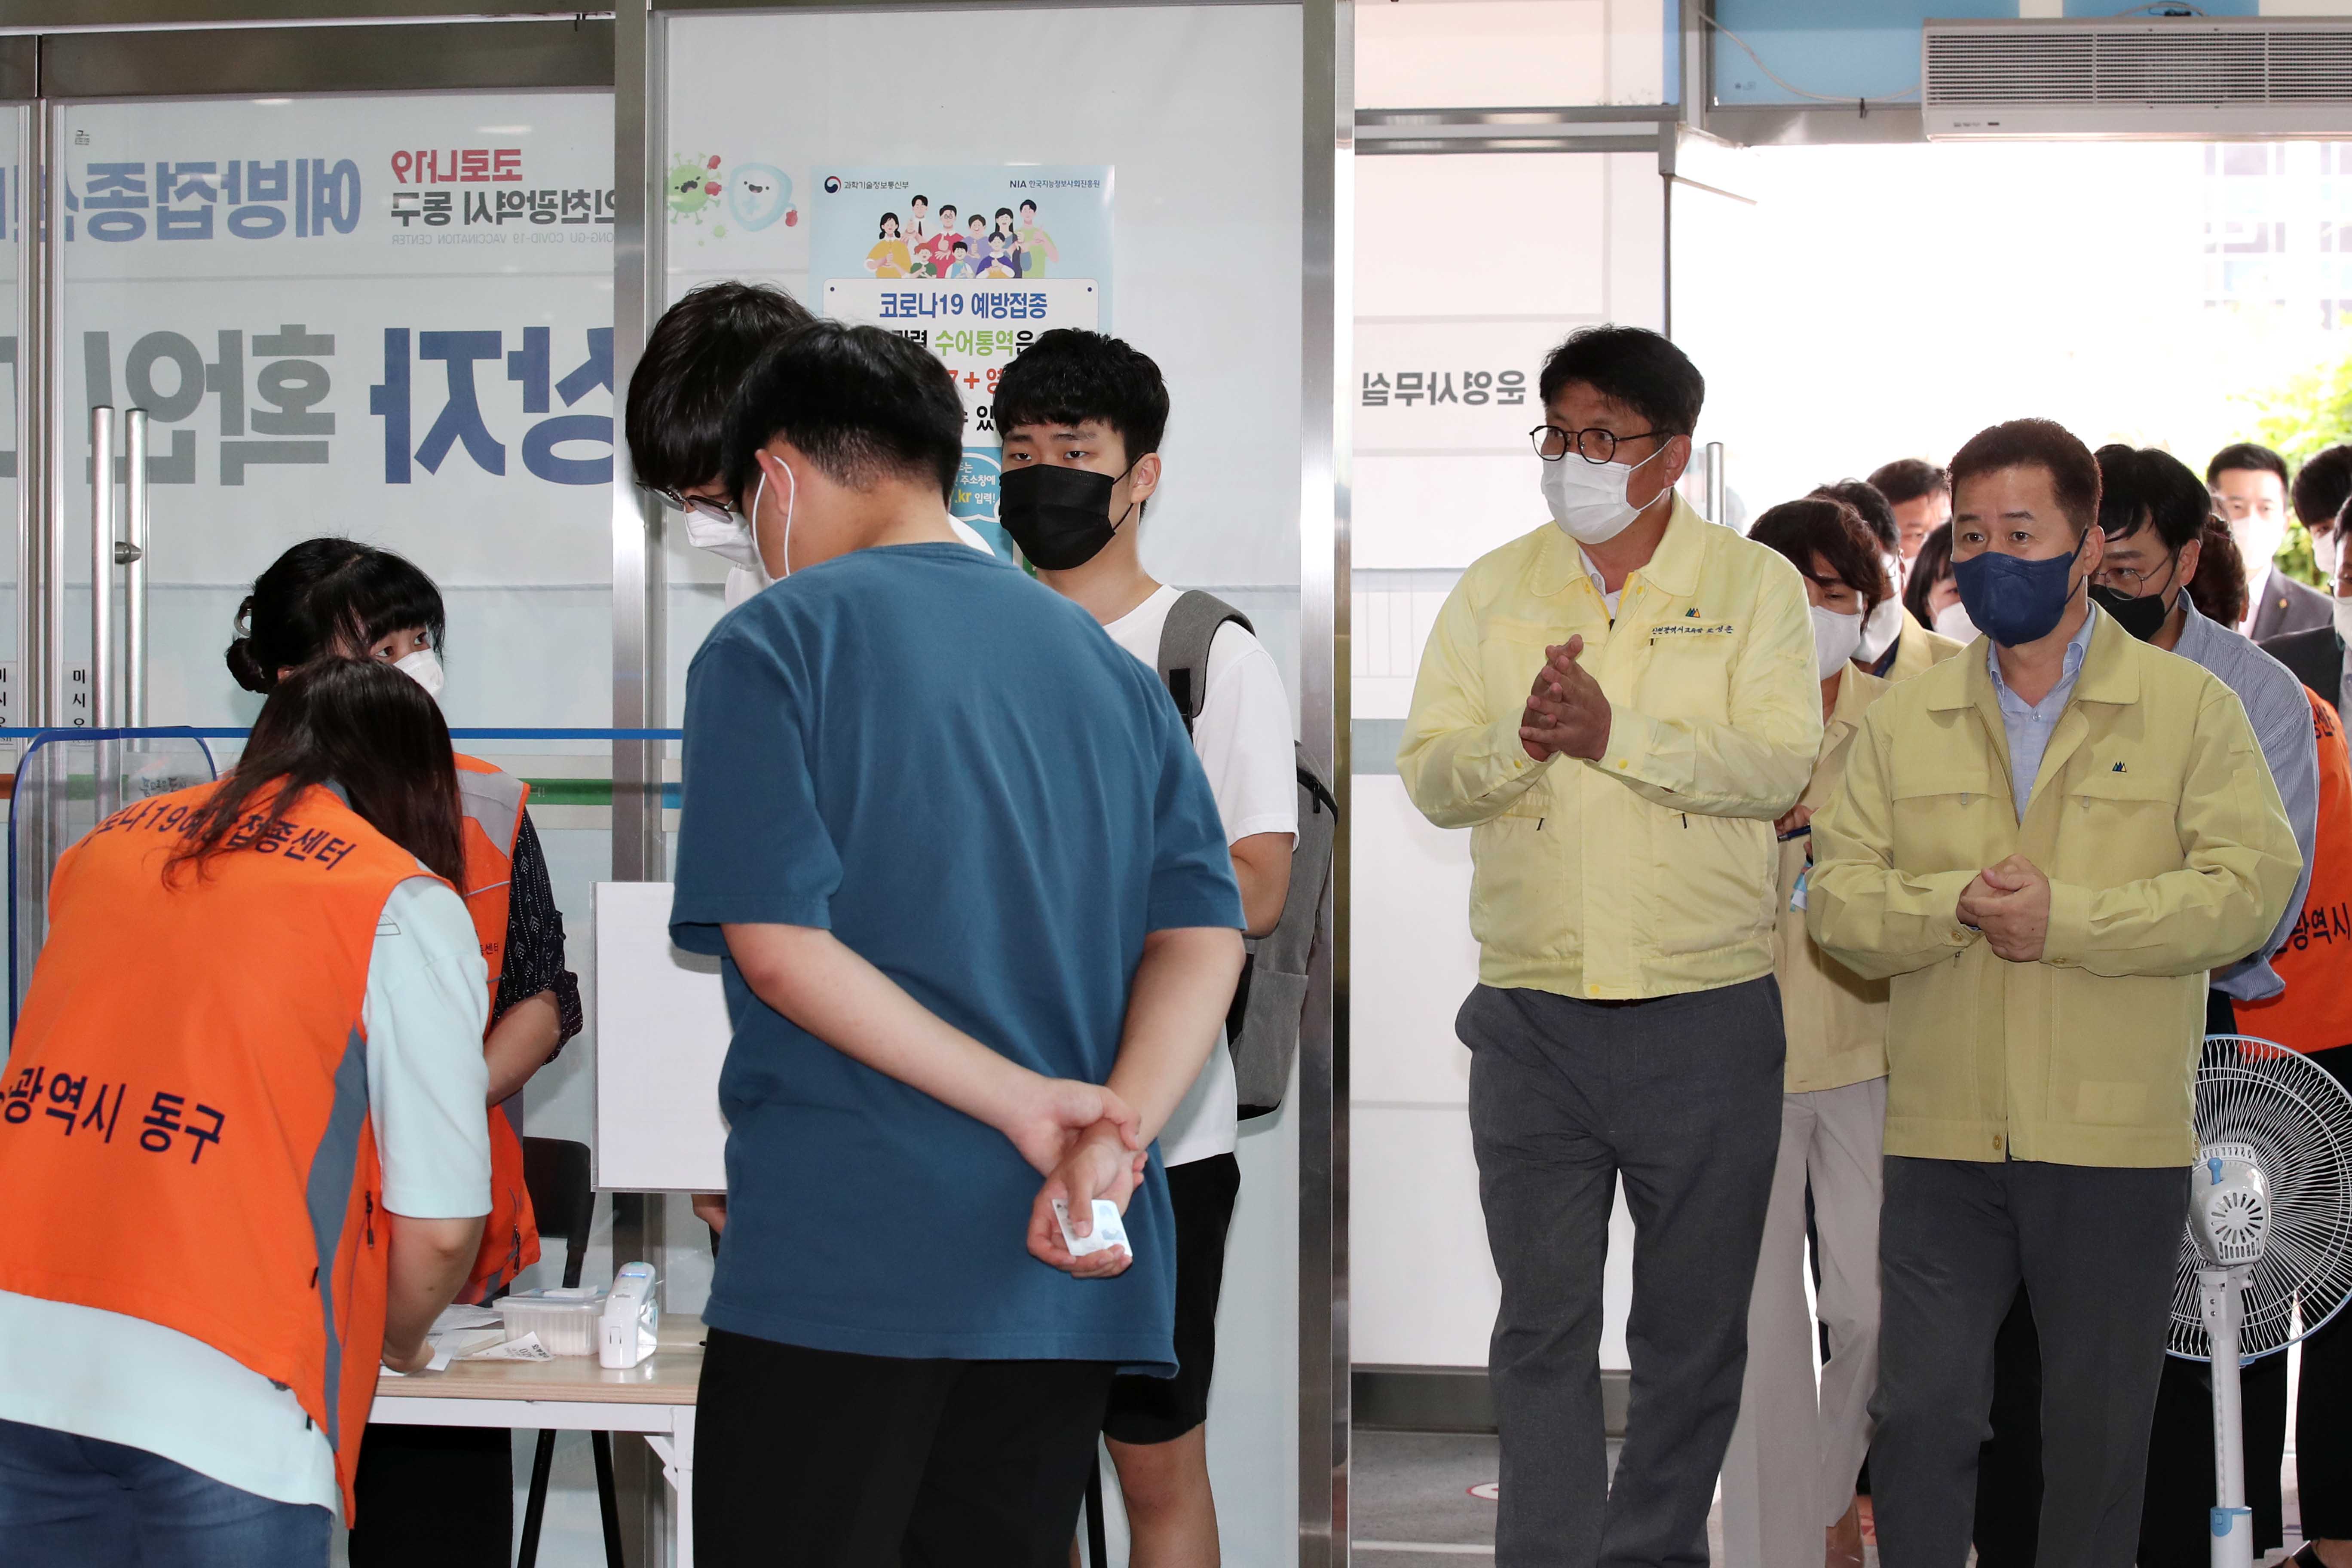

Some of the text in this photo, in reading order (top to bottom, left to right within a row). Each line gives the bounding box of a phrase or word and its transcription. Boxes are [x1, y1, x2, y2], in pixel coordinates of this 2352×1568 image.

[844, 181, 909, 190] 과학기술정보통신부
[1010, 180, 1027, 188] NIA
[1029, 179, 1100, 188] 한국지능정보사회진흥원
[879, 292, 1048, 319] 코로나19 예방접종
[960, 474, 996, 487] 주소창에
[974, 493, 995, 505] 입력!
[2276, 903, 2351, 954] 광역시
[0, 1066, 226, 1164] 광역시 동구
